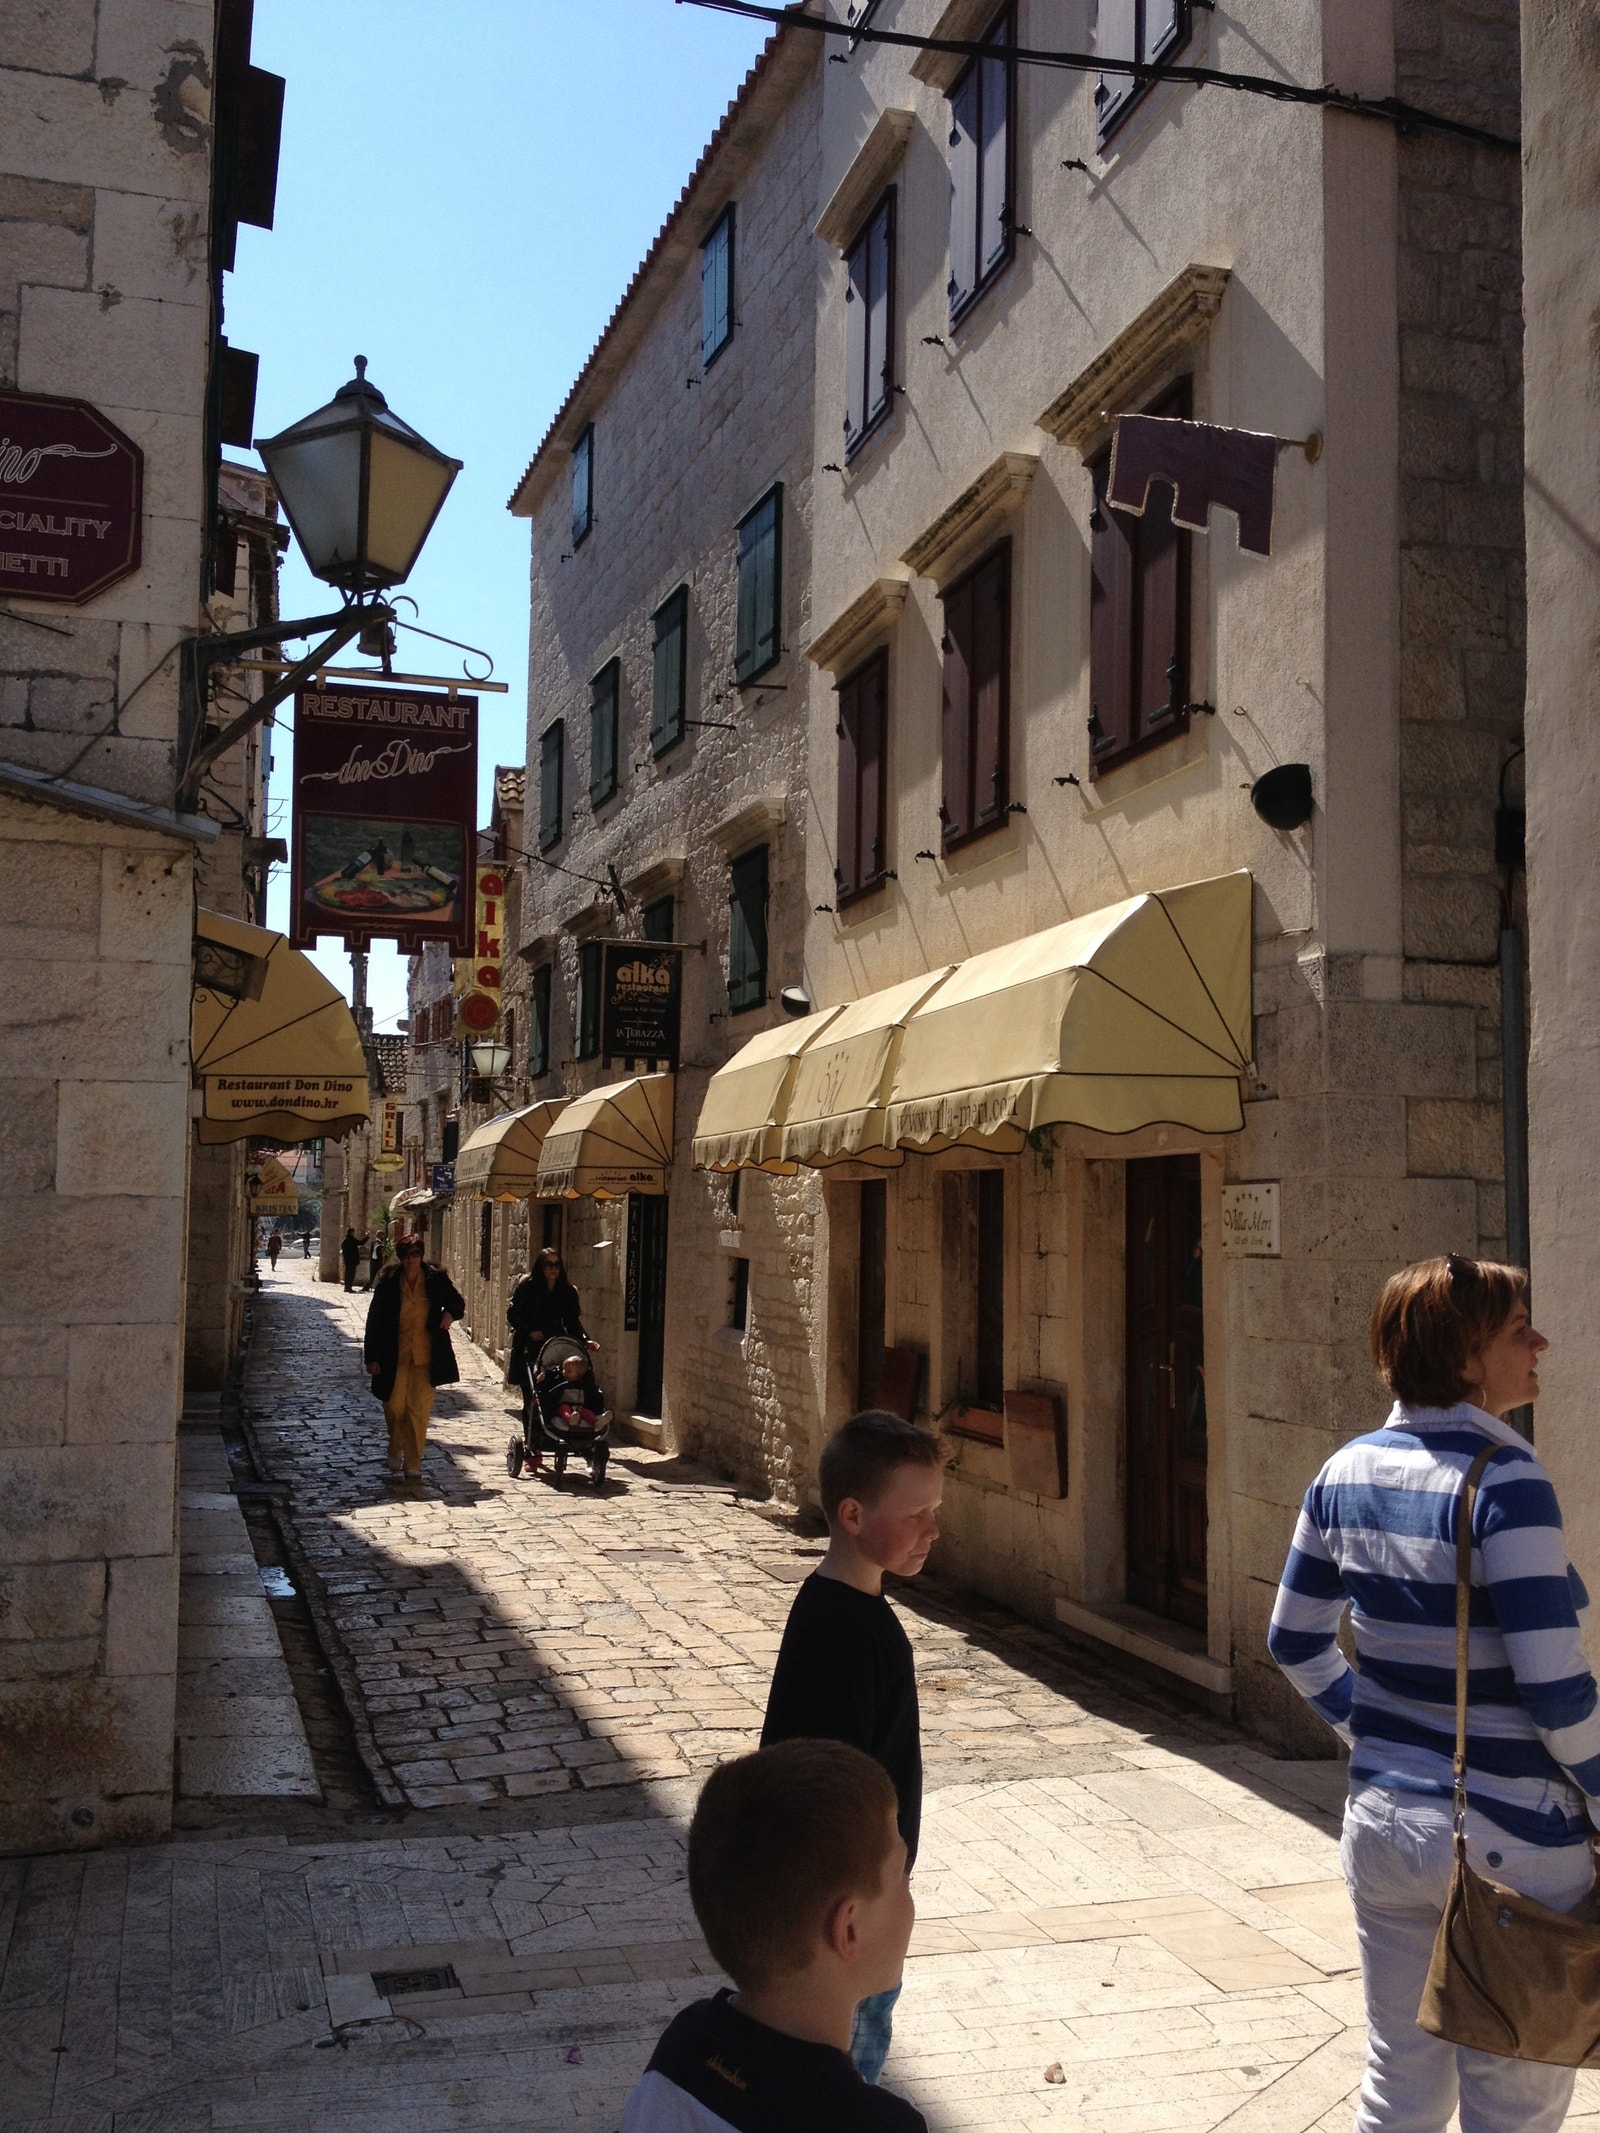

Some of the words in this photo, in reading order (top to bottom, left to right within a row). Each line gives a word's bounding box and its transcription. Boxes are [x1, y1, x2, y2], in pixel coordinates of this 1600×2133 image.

[302, 693, 470, 729] RESTAURANT
[477, 873, 504, 988] alka
[616, 961, 671, 984] alka
[616, 982, 670, 993] restaurant
[624, 1026, 666, 1041] TERAZZA
[217, 1079, 292, 1091] Restaurant
[294, 1079, 320, 1091] Don
[323, 1080, 353, 1092] Dino
[231, 1096, 339, 1109] www.dondino.hr
[384, 1102, 396, 1148] GRILL
[629, 1171, 654, 1182] alka
[1223, 1208, 1248, 1231] Villa
[628, 1250, 639, 1313] TERAZZA
